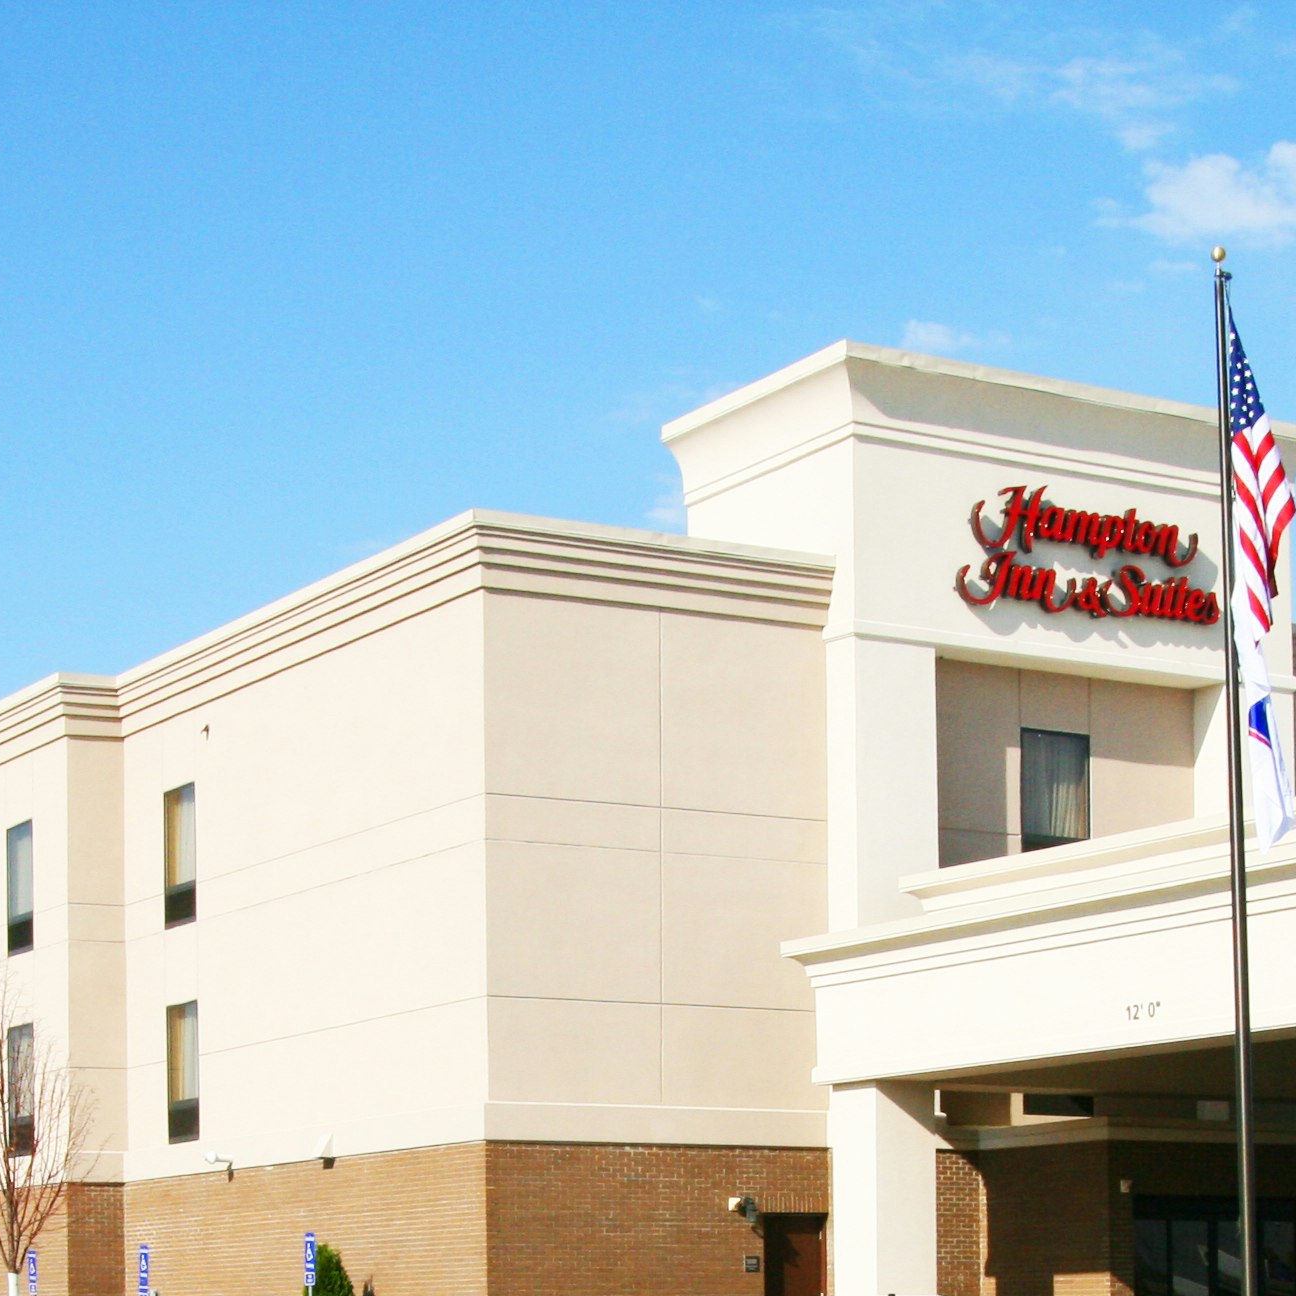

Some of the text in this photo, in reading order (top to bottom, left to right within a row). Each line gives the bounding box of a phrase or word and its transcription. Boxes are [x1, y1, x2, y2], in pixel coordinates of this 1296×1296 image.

[969, 485, 1199, 567] Hampton
[954, 551, 1076, 613] Inn
[1104, 565, 1221, 626] Suites
